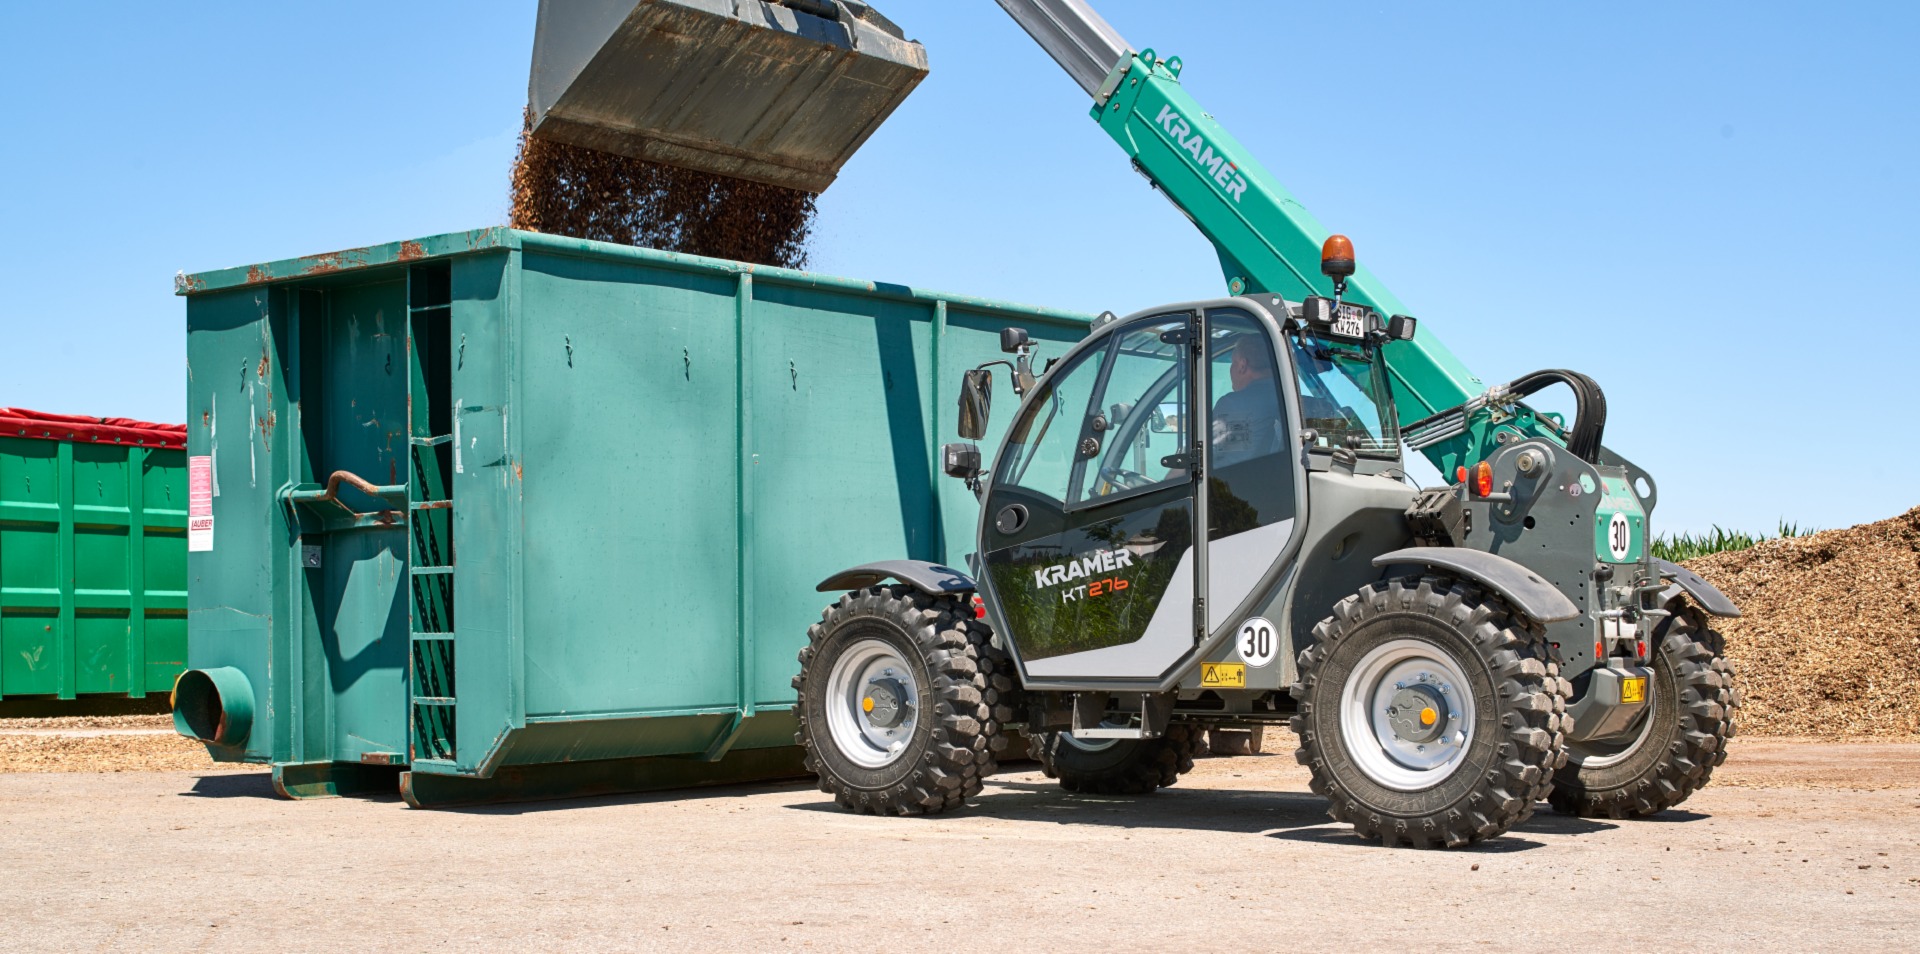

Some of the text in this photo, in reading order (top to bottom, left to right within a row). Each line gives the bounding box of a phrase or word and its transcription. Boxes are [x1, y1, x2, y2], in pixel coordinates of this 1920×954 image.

[1155, 103, 1248, 204] KRAMER
[1612, 520, 1626, 552] 30
[1034, 548, 1134, 589] KRAMER
[1062, 576, 1129, 604] KT 276
[1243, 626, 1270, 658] 30
